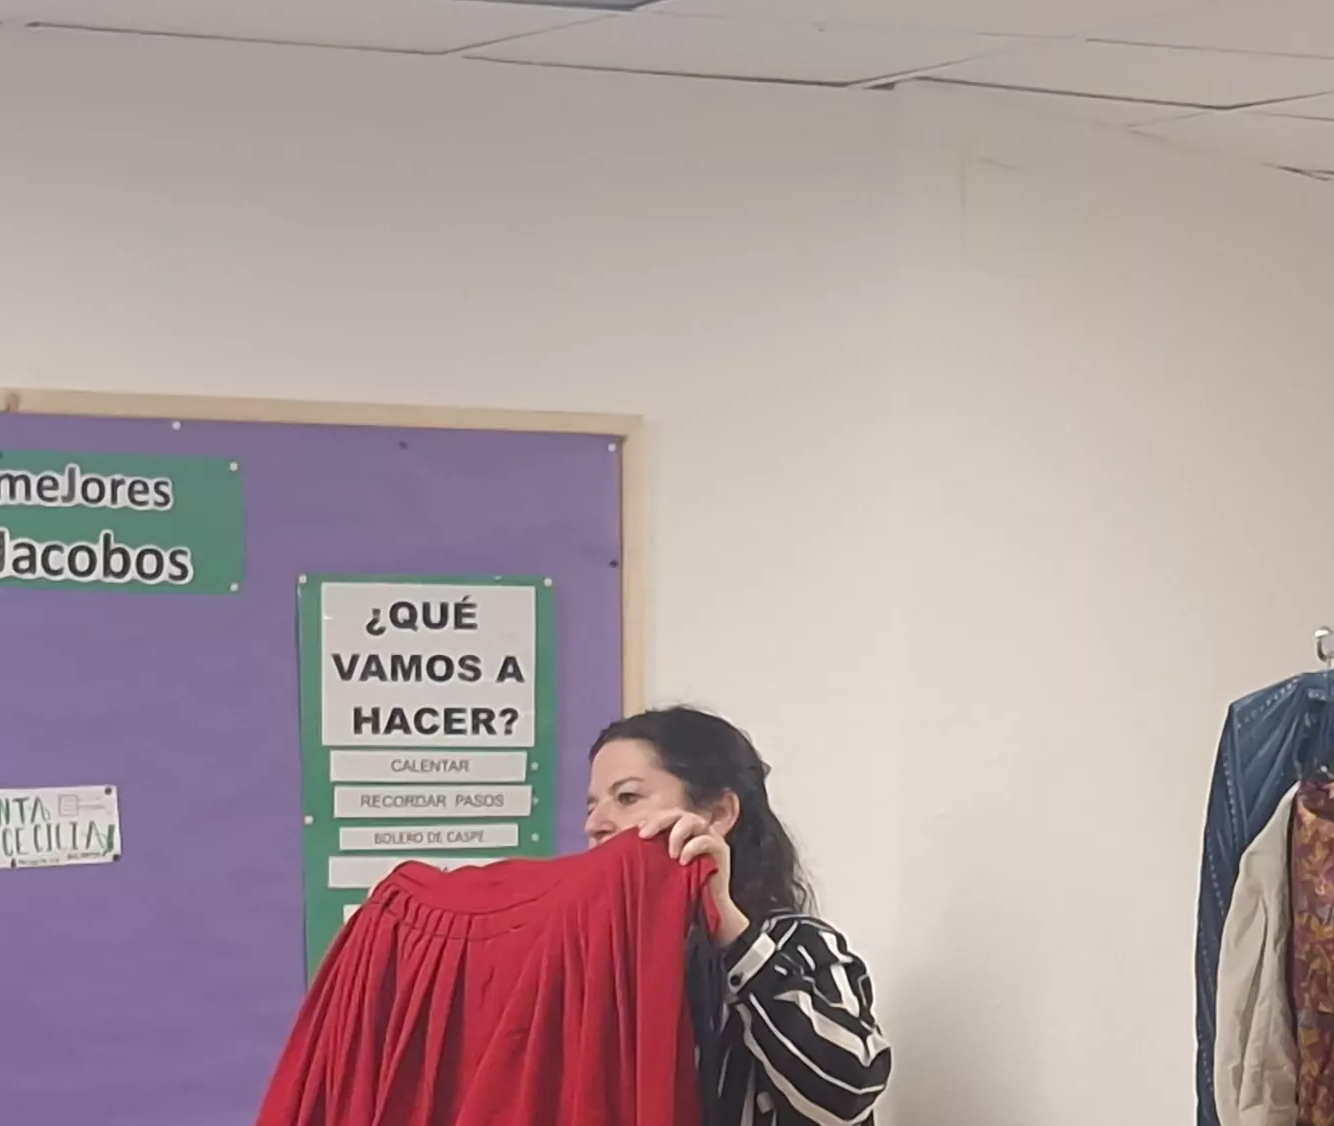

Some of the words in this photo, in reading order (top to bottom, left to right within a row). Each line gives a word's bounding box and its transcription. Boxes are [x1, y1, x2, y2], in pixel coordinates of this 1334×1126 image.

[365, 595, 478, 636] ¿QUÉ
[331, 653, 482, 683] VAMOS
[495, 656, 525, 683] A
[353, 707, 520, 736] HACER?
[391, 759, 470, 773] CALENTAR
[360, 794, 447, 808] RECORDAR
[455, 794, 505, 808] PASOS
[427, 832, 443, 844] DE
